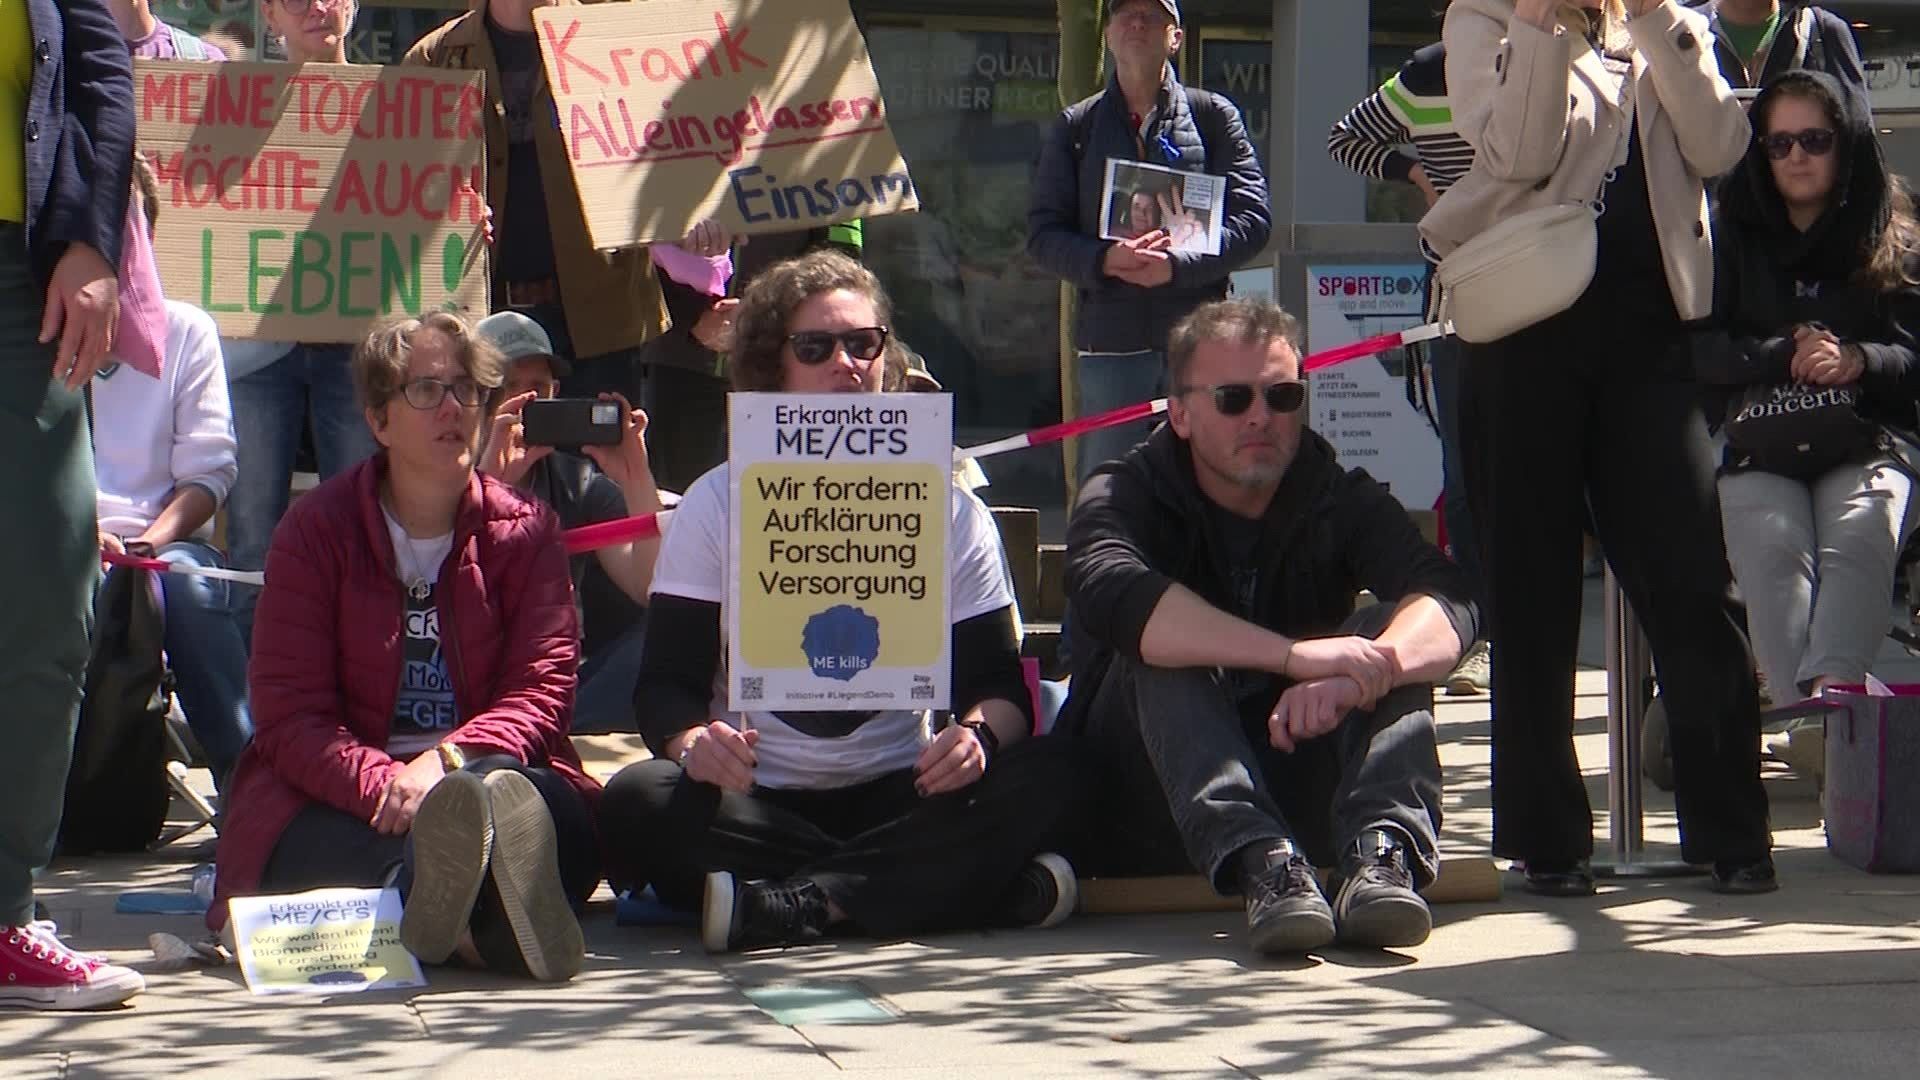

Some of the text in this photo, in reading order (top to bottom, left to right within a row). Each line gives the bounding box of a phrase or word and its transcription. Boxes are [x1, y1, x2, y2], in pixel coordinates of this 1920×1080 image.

[543, 12, 768, 94] Krank
[143, 73, 484, 140] MEINE TOCHTER
[571, 95, 880, 166] Alleingelassen
[147, 144, 482, 225] MÖCHTE AUCH
[729, 166, 911, 223] Einsam
[1319, 276, 1424, 296] SPORTBOX
[775, 405, 908, 425] Erkrankt an
[776, 426, 908, 459] ME/CFS
[757, 476, 928, 501] Wir fordern:
[763, 508, 922, 537] Aufklärung
[769, 540, 917, 569] Forschung
[759, 571, 926, 600] Versorgung
[813, 655, 868, 669] ME kills
[269, 898, 369, 914] Erkrankt an
[271, 907, 371, 926] ME/CFS
[254, 935, 281, 946] Wir
[287, 931, 341, 943] wollen
[277, 951, 378, 967] Forschung
